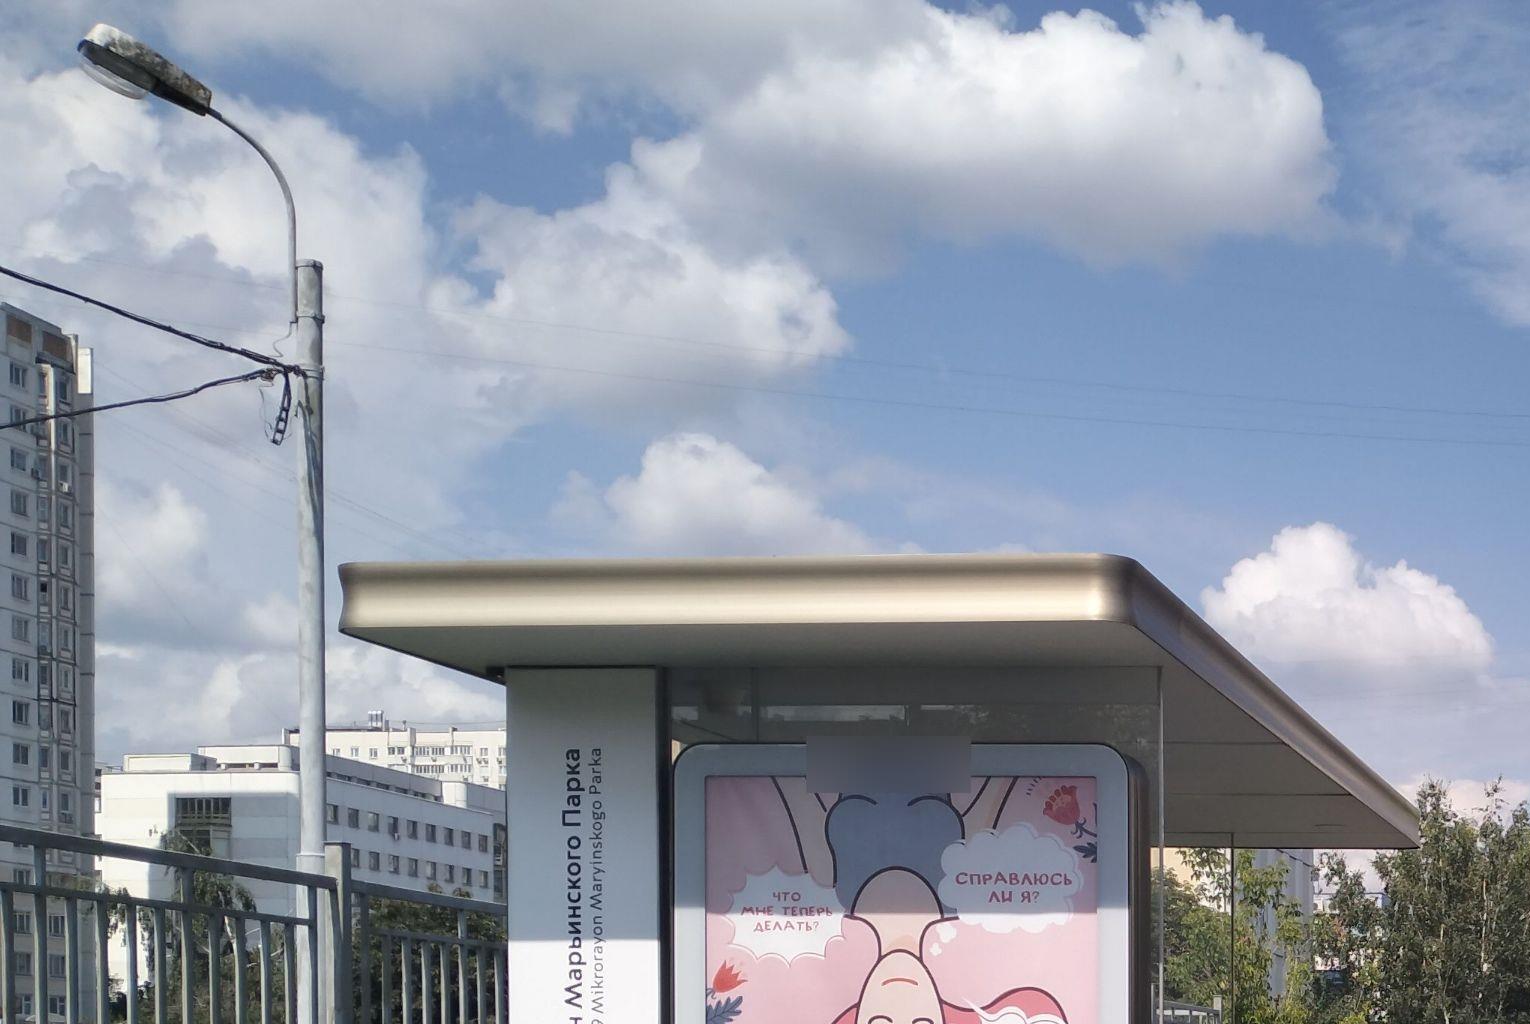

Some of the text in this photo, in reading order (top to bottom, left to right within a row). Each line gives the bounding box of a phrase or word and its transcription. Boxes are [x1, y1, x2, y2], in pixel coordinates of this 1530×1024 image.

[588, 747, 602, 795] Parka
[561, 748, 586, 827] Парка
[588, 800, 606, 911] Maryinskogo
[954, 871, 1073, 886] СПРАВЛЮСЬ
[740, 905, 833, 917] МНЕ ТЕПЕРЬ
[772, 891, 801, 902] ЧТО
[988, 890, 1040, 903] ЛИ Я?
[563, 835, 587, 1009] Марьинского
[753, 920, 820, 933] ДЕЛАТЬ?
[590, 915, 606, 1014] Mikrorayon
